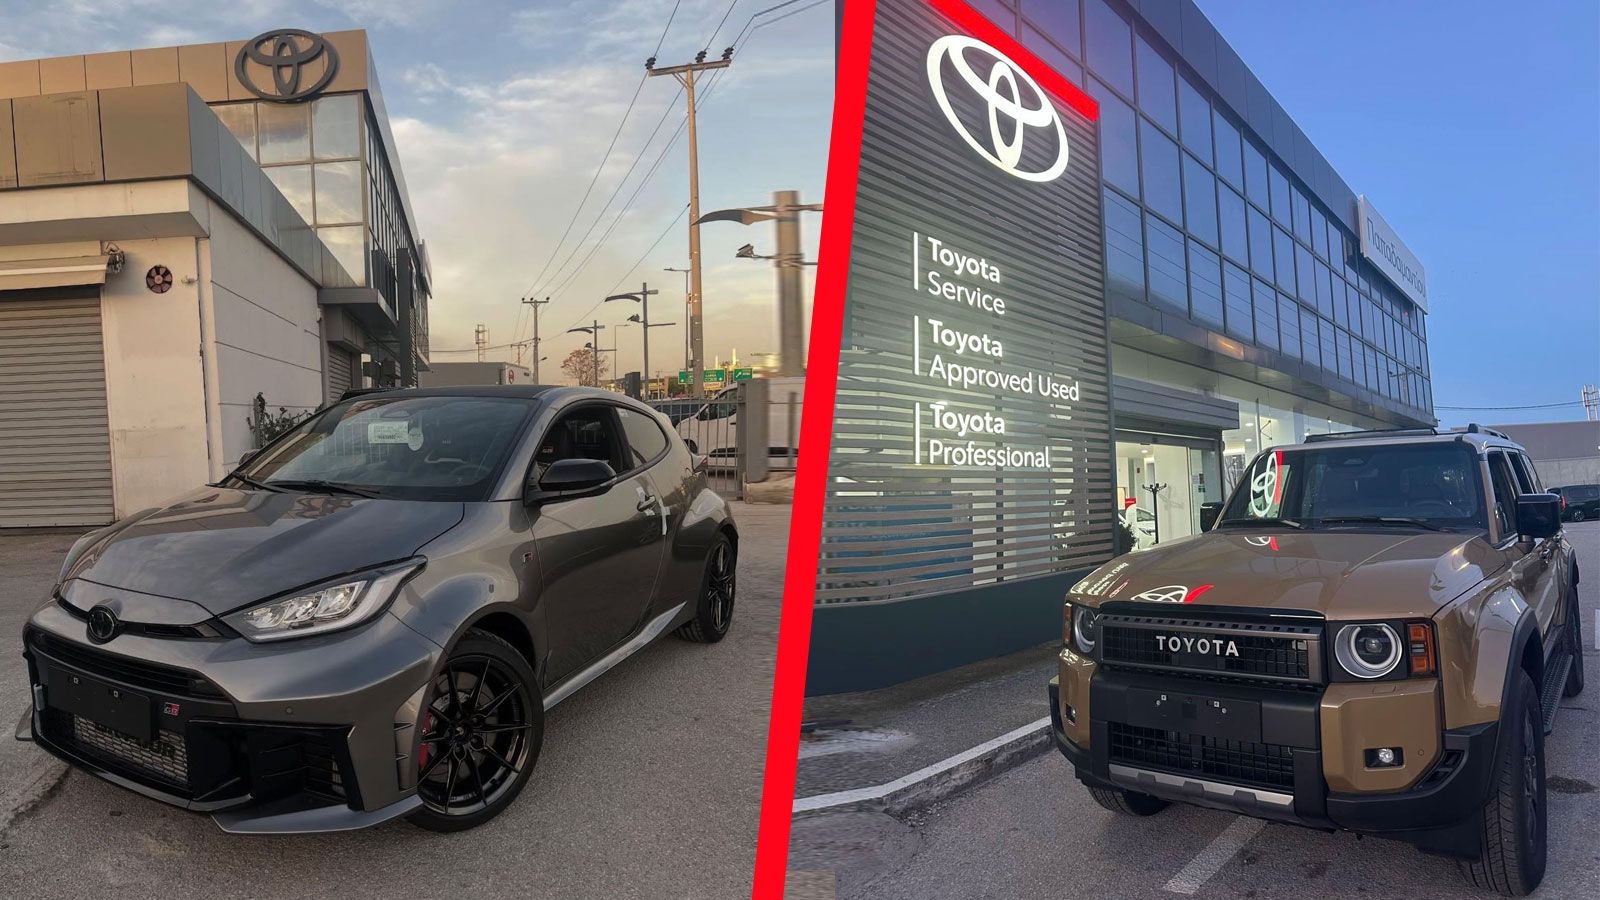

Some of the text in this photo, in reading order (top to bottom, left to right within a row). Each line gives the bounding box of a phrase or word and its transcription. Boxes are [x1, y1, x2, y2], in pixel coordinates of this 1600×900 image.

[927, 236, 1001, 283] Toyota
[927, 270, 1006, 315] Service
[928, 318, 1003, 357] Toyota
[929, 354, 1079, 402] Approved Used
[929, 403, 1006, 436] Toyota
[929, 439, 1051, 469] Professional
[1156, 635, 1240, 657] TOYOTA
